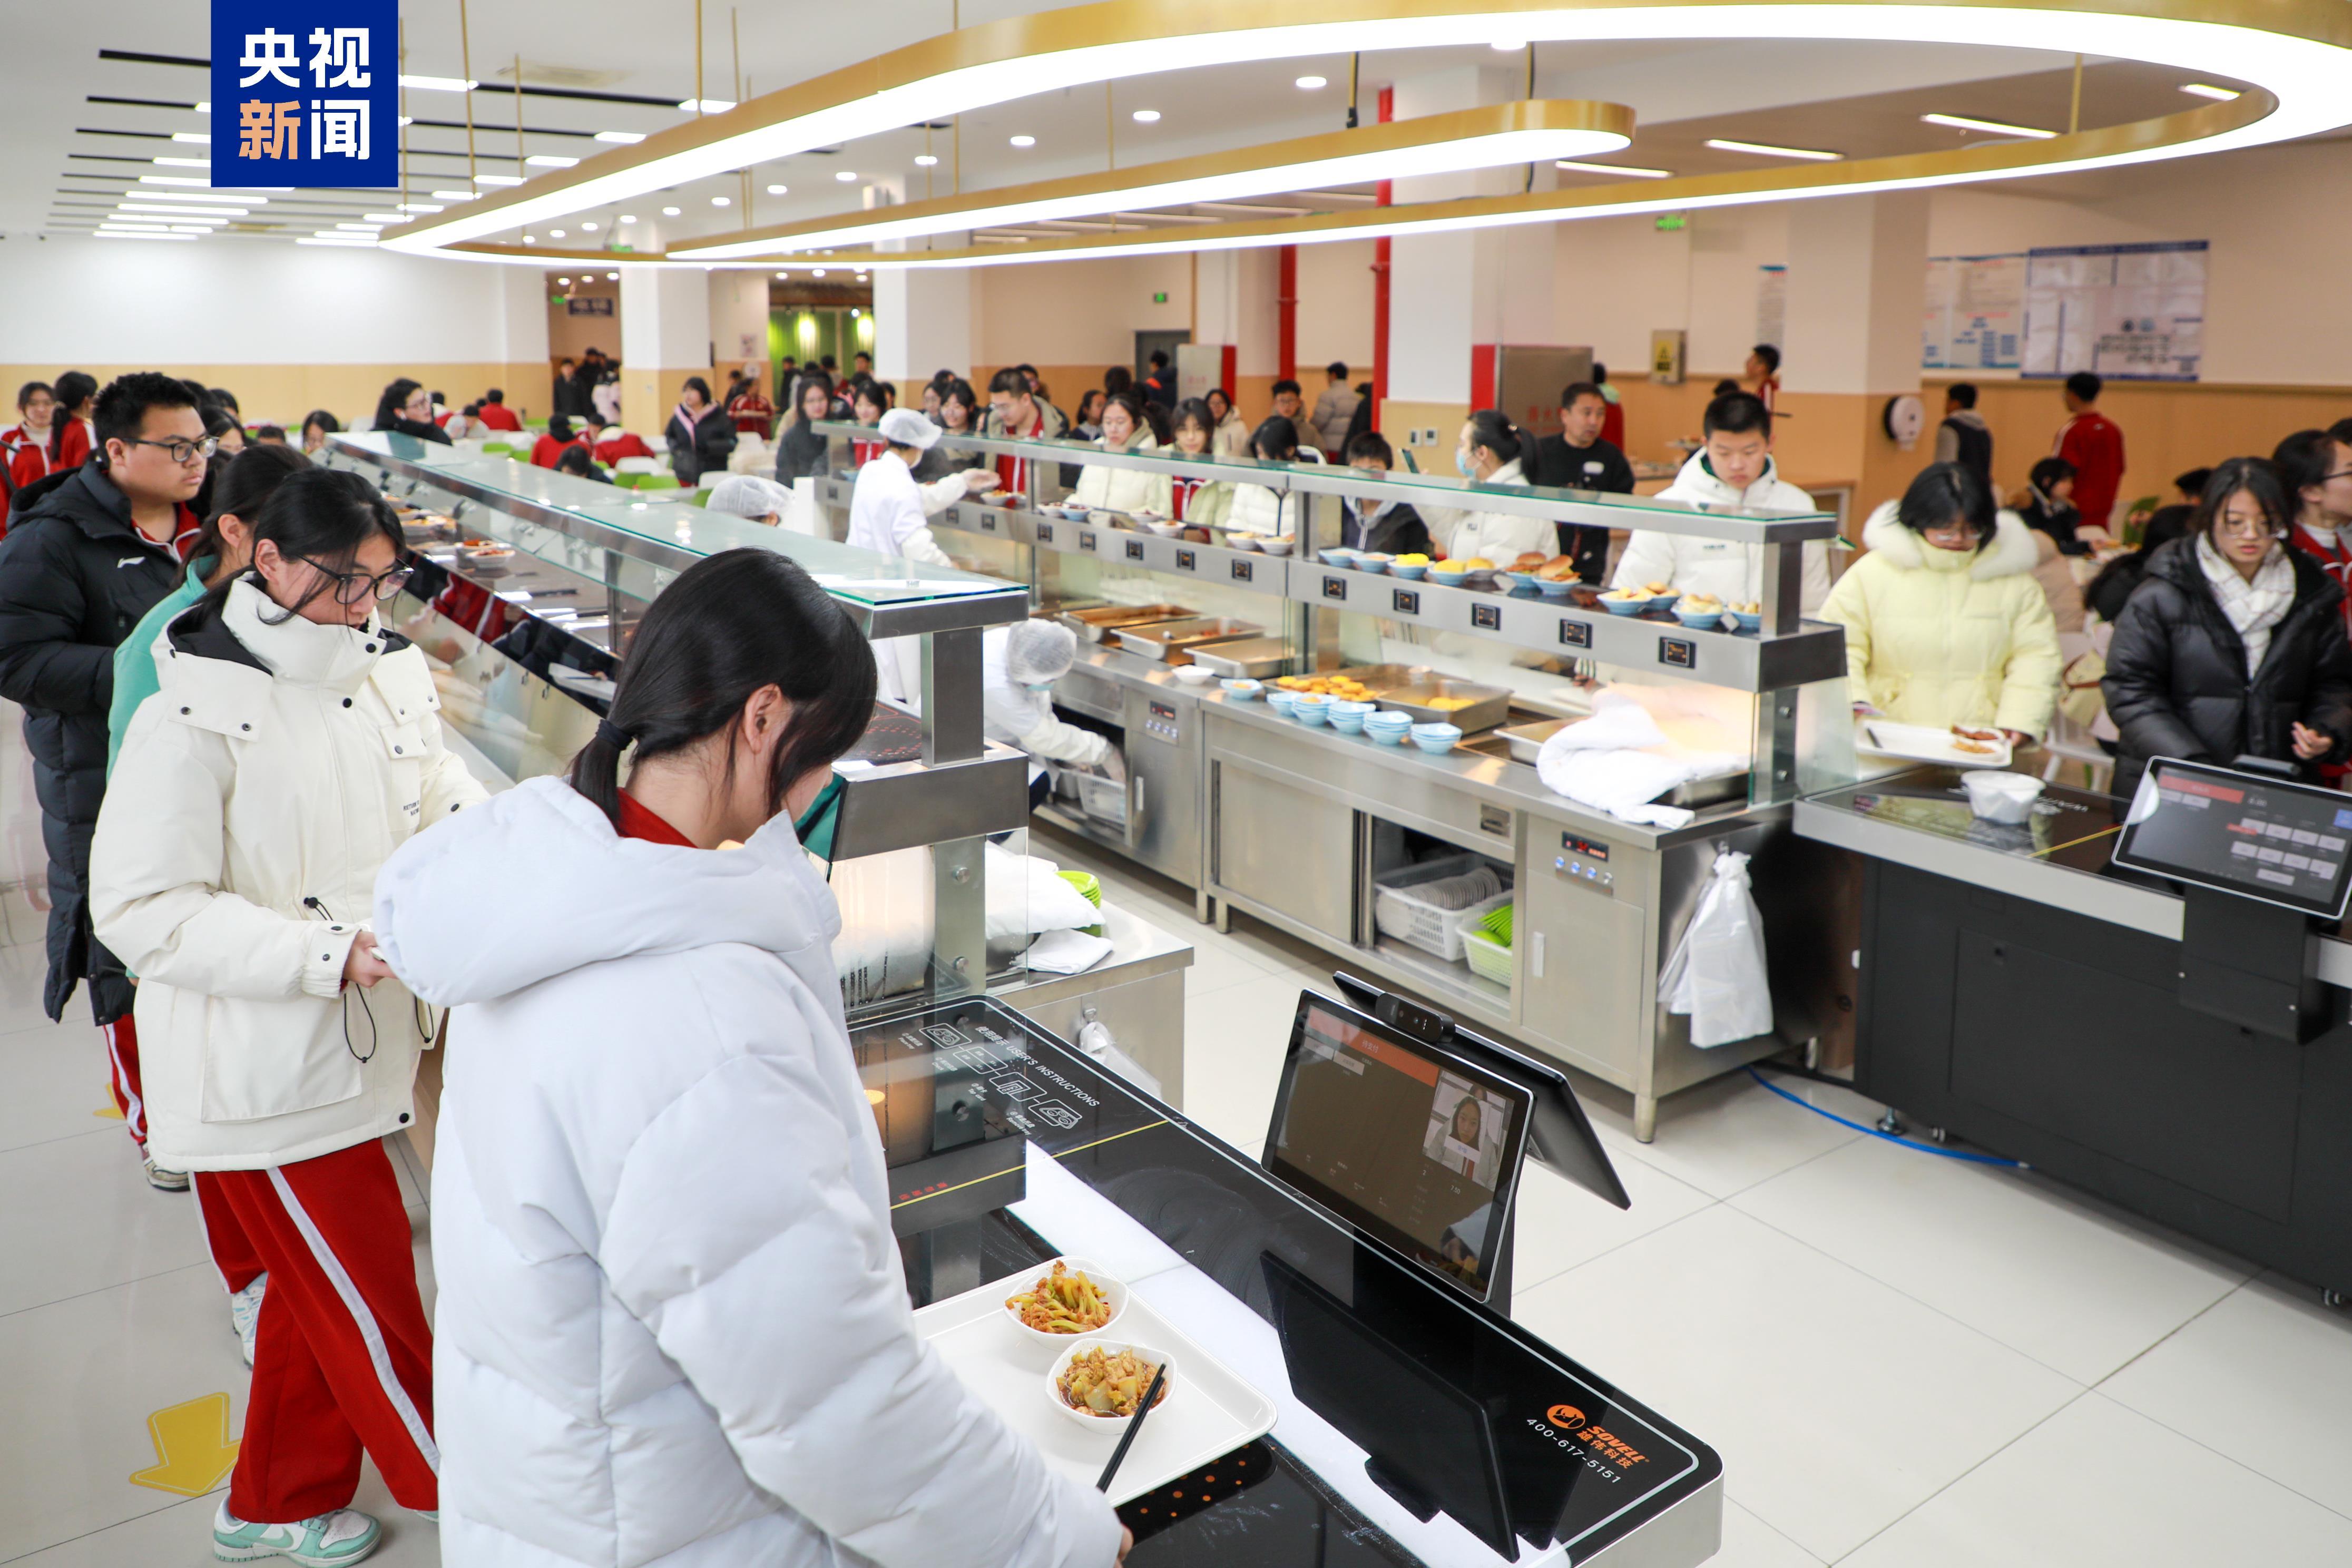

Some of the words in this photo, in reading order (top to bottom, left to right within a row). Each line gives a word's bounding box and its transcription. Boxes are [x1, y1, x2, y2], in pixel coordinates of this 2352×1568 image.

[1361, 1040, 1379, 1054] 待支付
[975, 1026, 1010, 1046] 使用提示
[1006, 1045, 1038, 1066] USER'S
[1035, 1065, 1100, 1107] INSTRUCTIONS
[1006, 1117, 1024, 1130] Remove
[1450, 1184, 1461, 1195] 7.50
[1526, 1418, 1621, 1483] 400-617-5151
[1576, 1430, 1634, 1469] 雄伟科技
[1586, 1425, 1646, 1463] SOVELL
